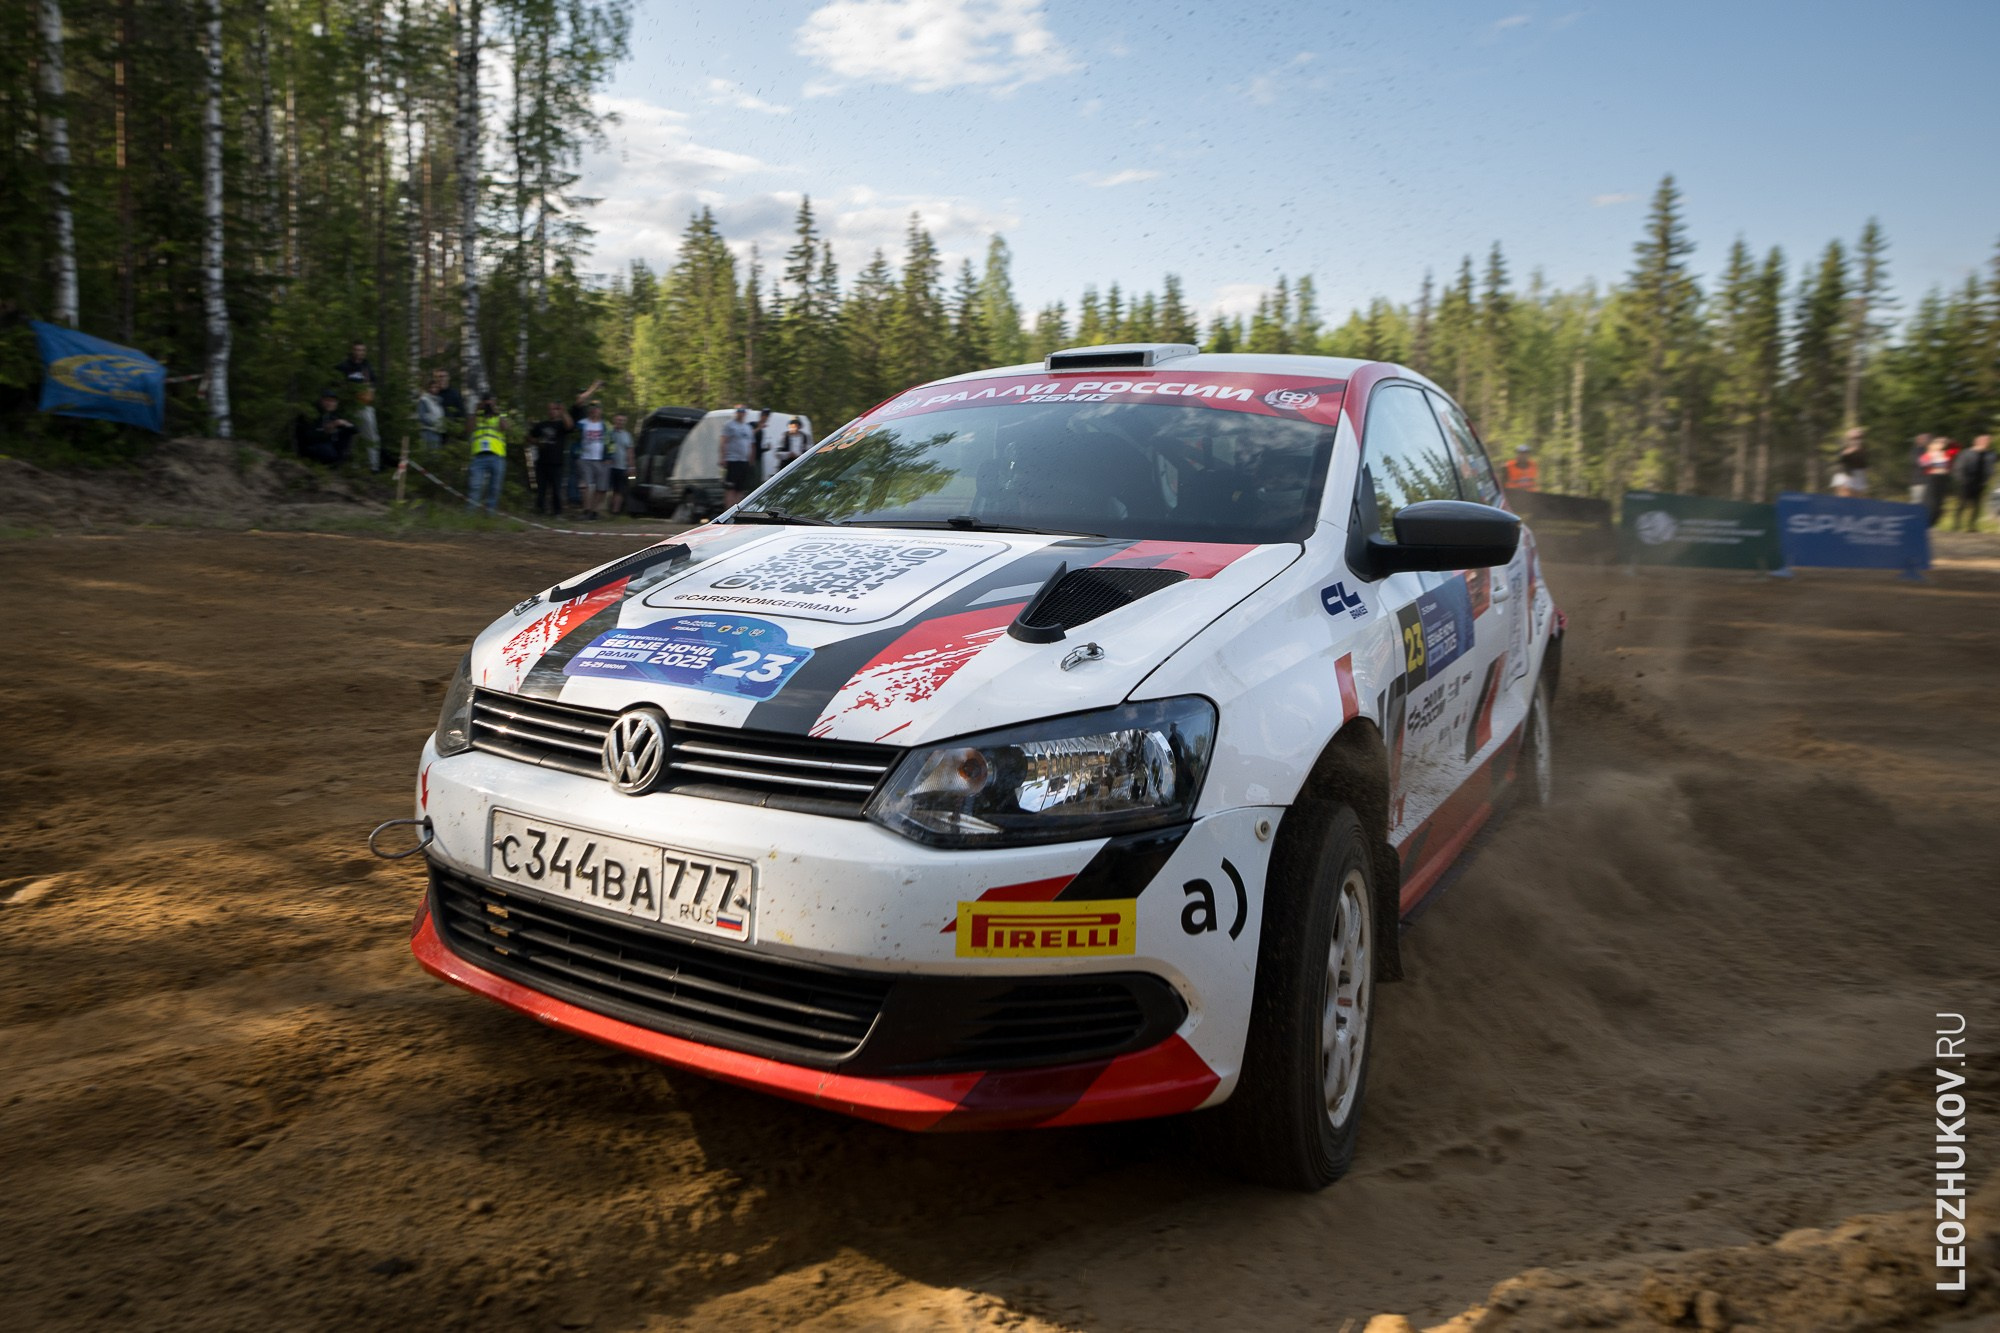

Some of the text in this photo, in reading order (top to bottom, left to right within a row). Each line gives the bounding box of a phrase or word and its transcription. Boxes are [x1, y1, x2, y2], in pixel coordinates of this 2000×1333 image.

[921, 383, 1060, 408] РАЛЛИ
[1069, 381, 1254, 401] РОССИИ
[816, 423, 882, 454] 23
[1786, 513, 1910, 535] SPACE
[674, 594, 858, 614] @CARSFROMGERMANY
[595, 650, 639, 659] ралли
[601, 638, 664, 652] БЕЛЫЕ
[662, 643, 718, 657] НОЧИ
[1404, 622, 1424, 673] 23
[647, 651, 714, 670] 2025
[712, 650, 797, 683] 23
[665, 857, 738, 911] 777
[680, 903, 714, 925] RUS
[971, 912, 1121, 948] PIRELLI
